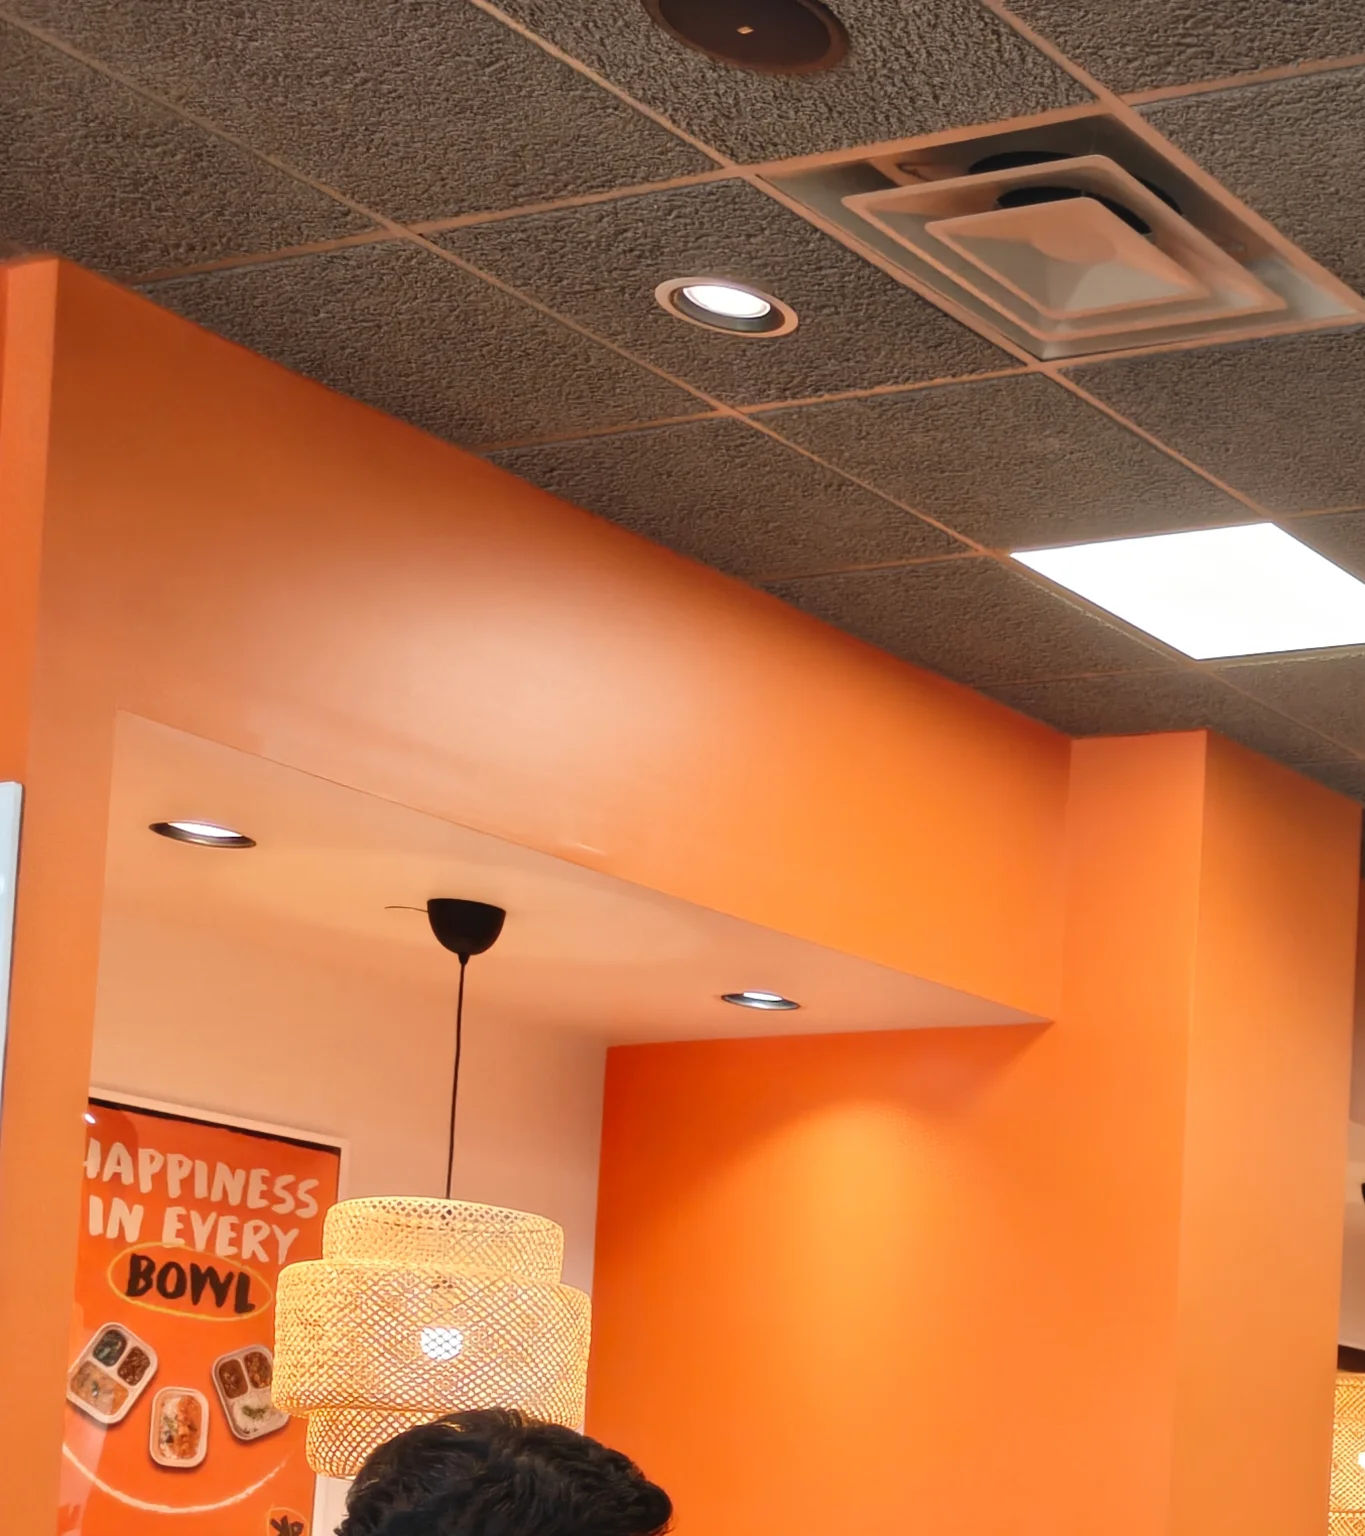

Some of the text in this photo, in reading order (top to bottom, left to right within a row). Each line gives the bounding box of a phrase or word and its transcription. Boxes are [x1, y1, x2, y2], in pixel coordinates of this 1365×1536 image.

[89, 1195, 299, 1265] IN EVERY
[126, 1253, 255, 1314] BOWL
